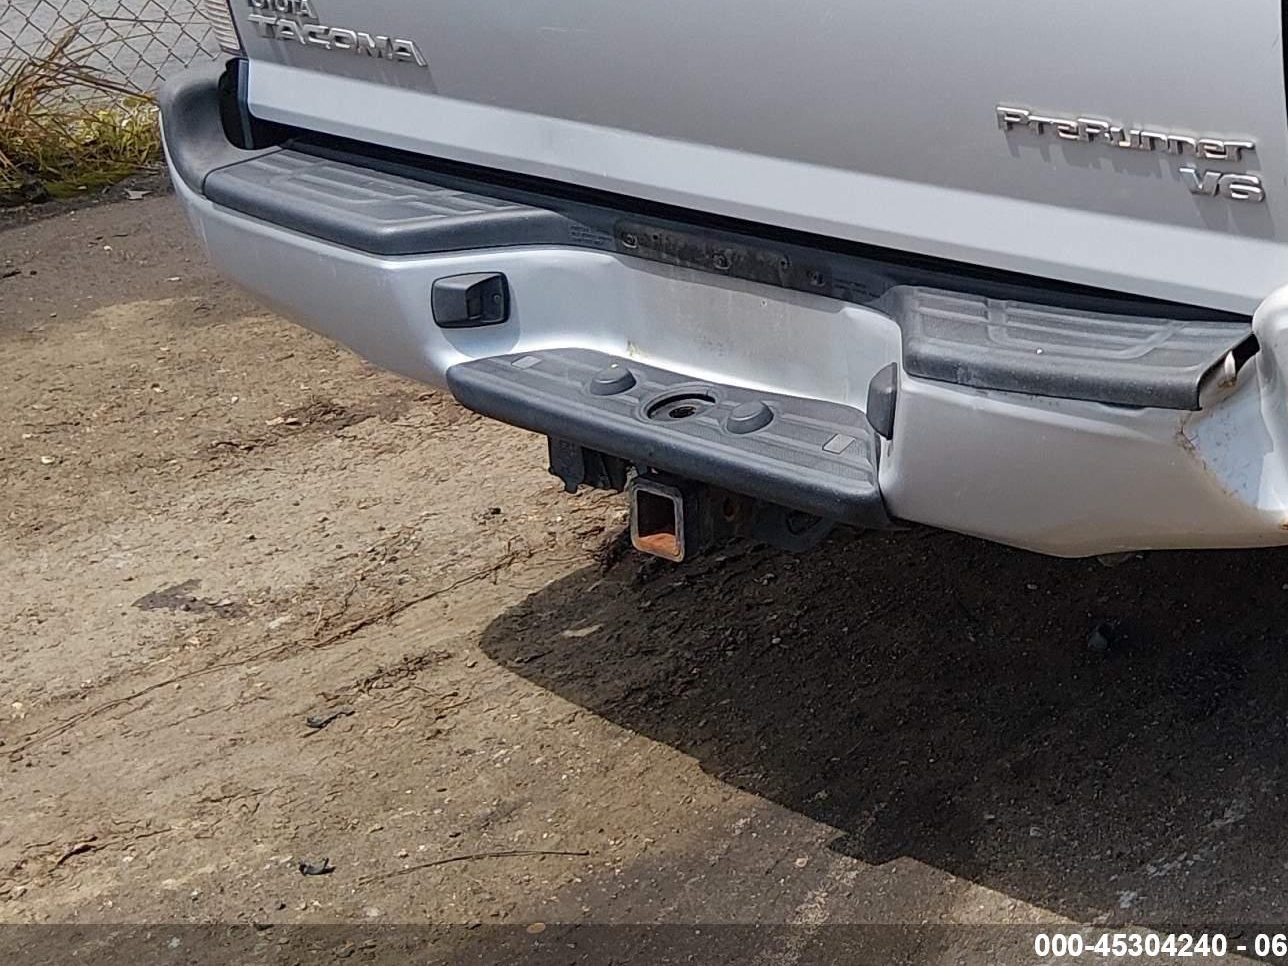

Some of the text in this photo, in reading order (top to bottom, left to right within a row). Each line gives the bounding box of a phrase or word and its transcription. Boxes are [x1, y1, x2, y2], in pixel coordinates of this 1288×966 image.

[247, 14, 428, 67] TACOMA
[995, 105, 1256, 162] PreRunner
[1178, 165, 1266, 204] V6
